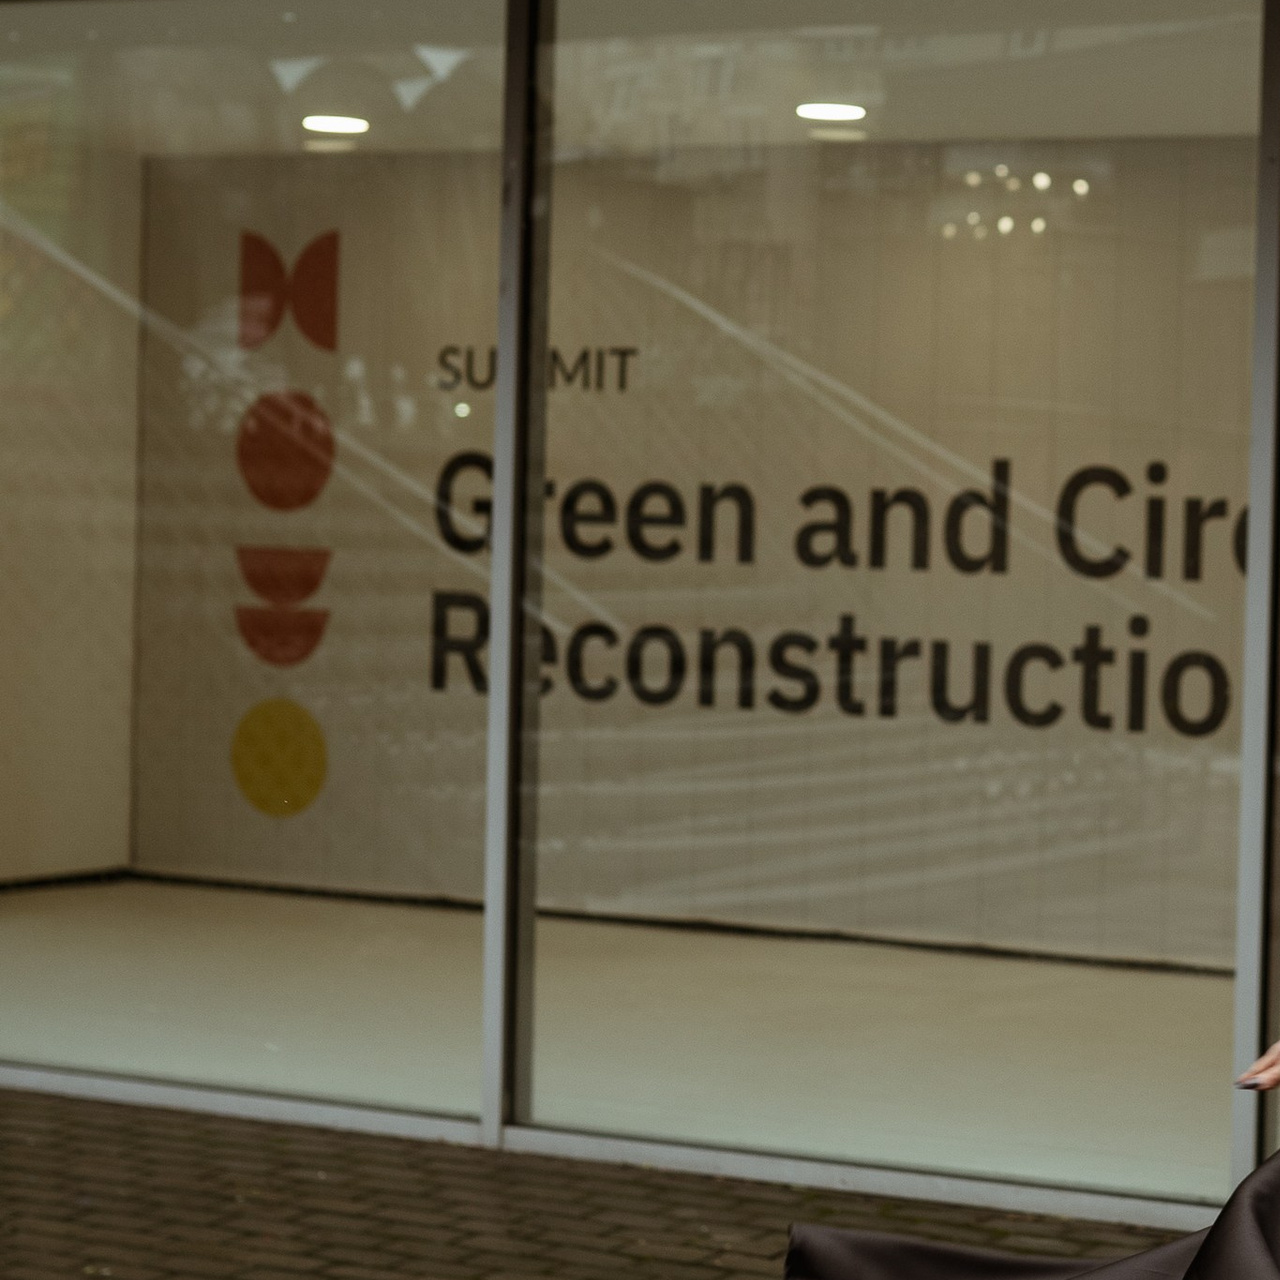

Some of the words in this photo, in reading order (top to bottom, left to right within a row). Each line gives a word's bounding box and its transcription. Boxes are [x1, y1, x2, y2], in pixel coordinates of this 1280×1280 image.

[437, 344, 639, 393] SUMIT
[436, 450, 756, 563] Geen
[793, 459, 1012, 574] and
